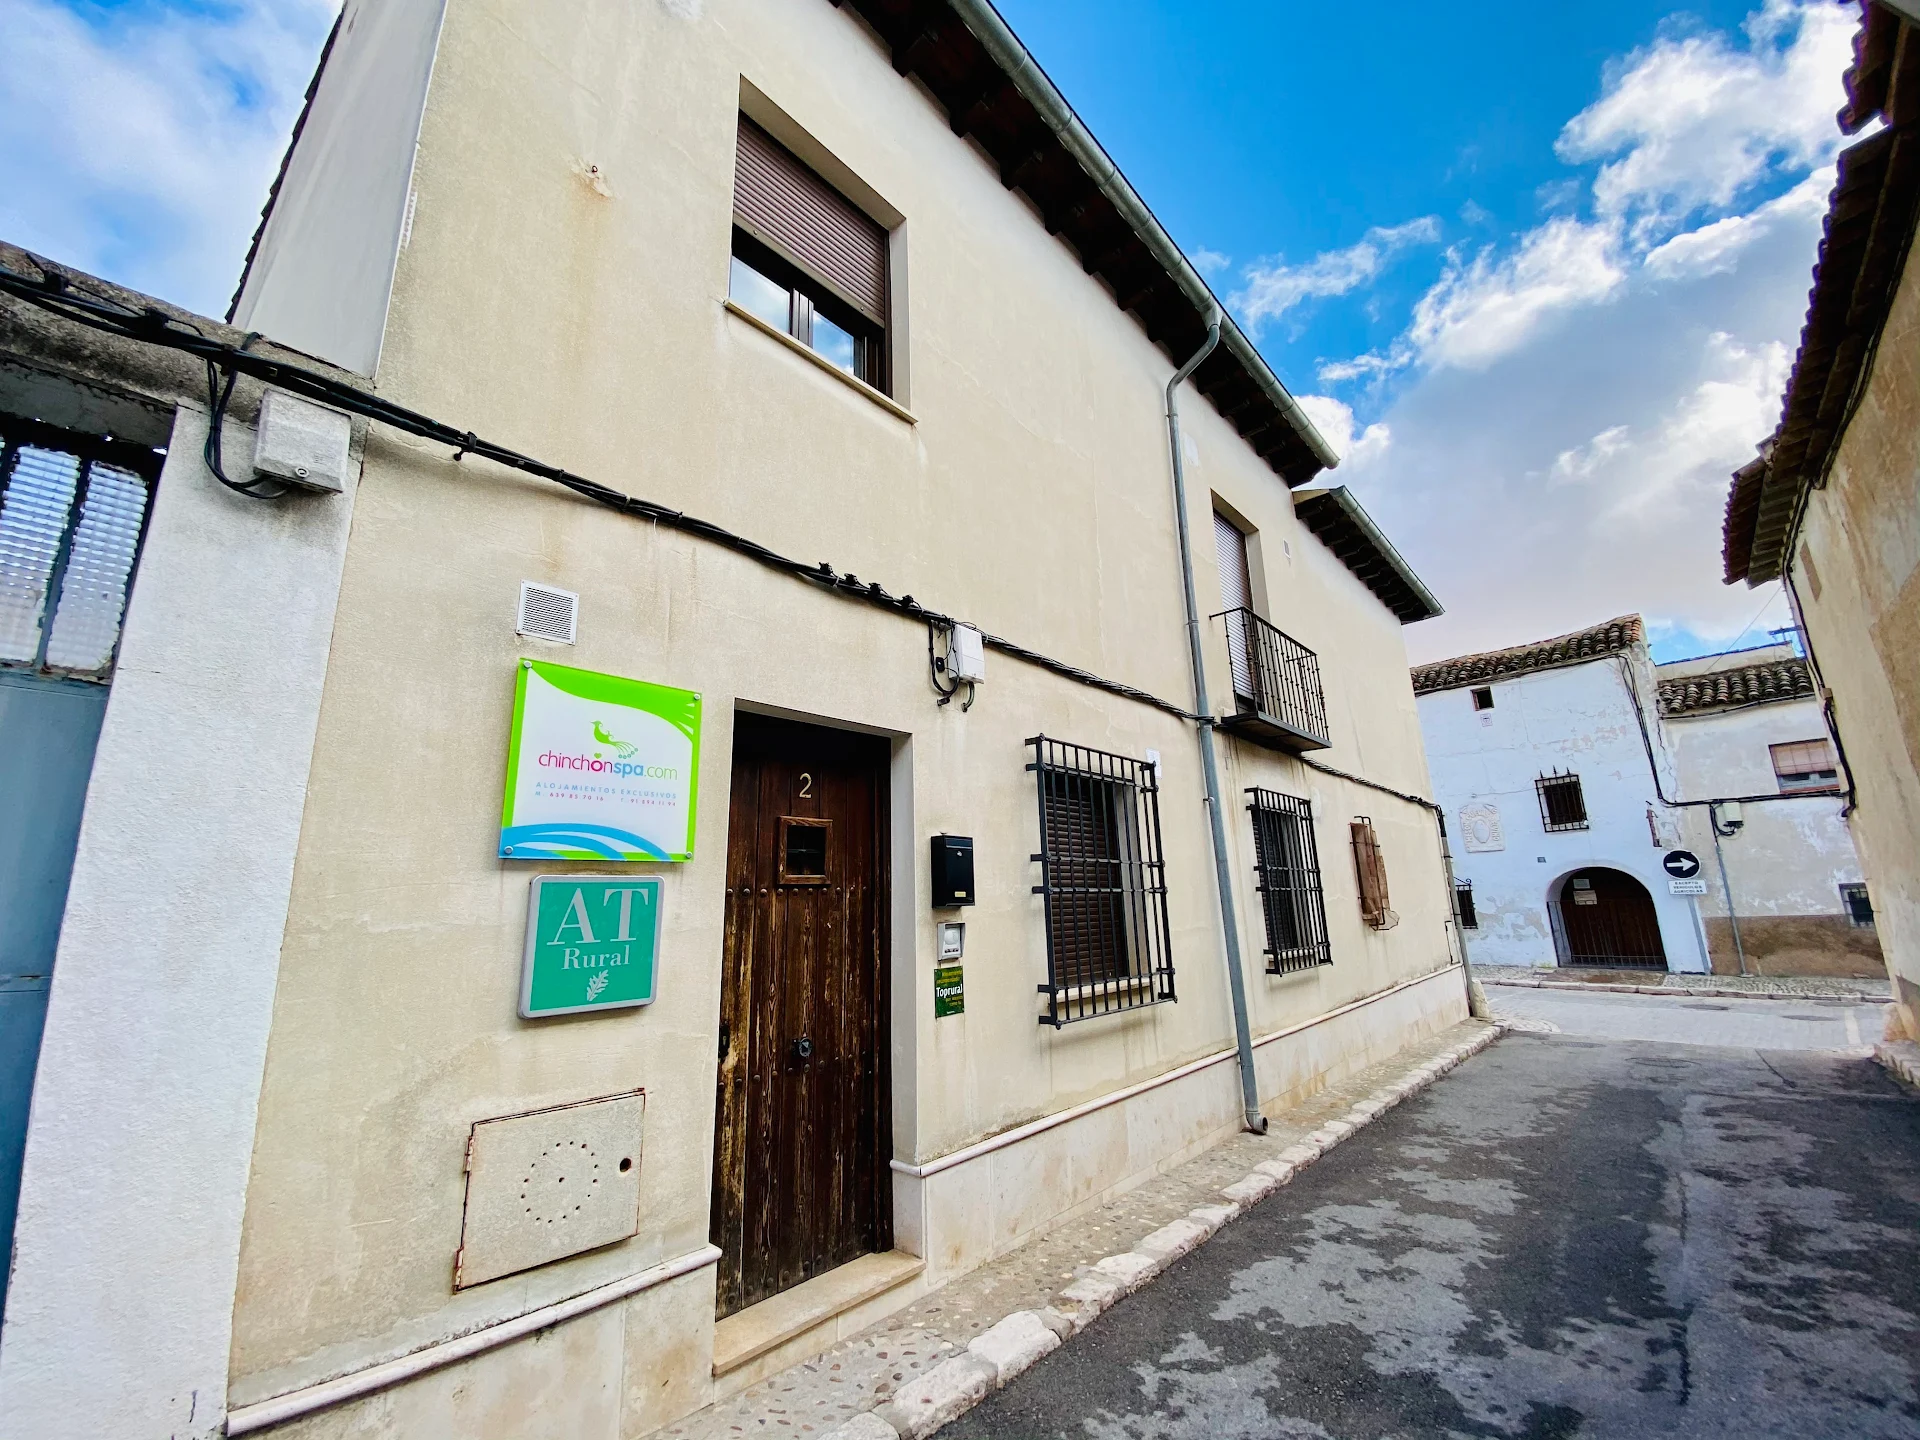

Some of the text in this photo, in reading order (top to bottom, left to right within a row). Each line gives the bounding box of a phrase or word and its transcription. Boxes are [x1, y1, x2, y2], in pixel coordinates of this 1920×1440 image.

[538, 750, 678, 780] chinchonspa.com
[536, 782, 677, 799] ALOJAMIENTOS EXCLUSIVOS
[799, 772, 812, 799] 2
[547, 888, 649, 945] AT
[561, 945, 631, 970] Rural
[936, 984, 963, 998] Toprural
